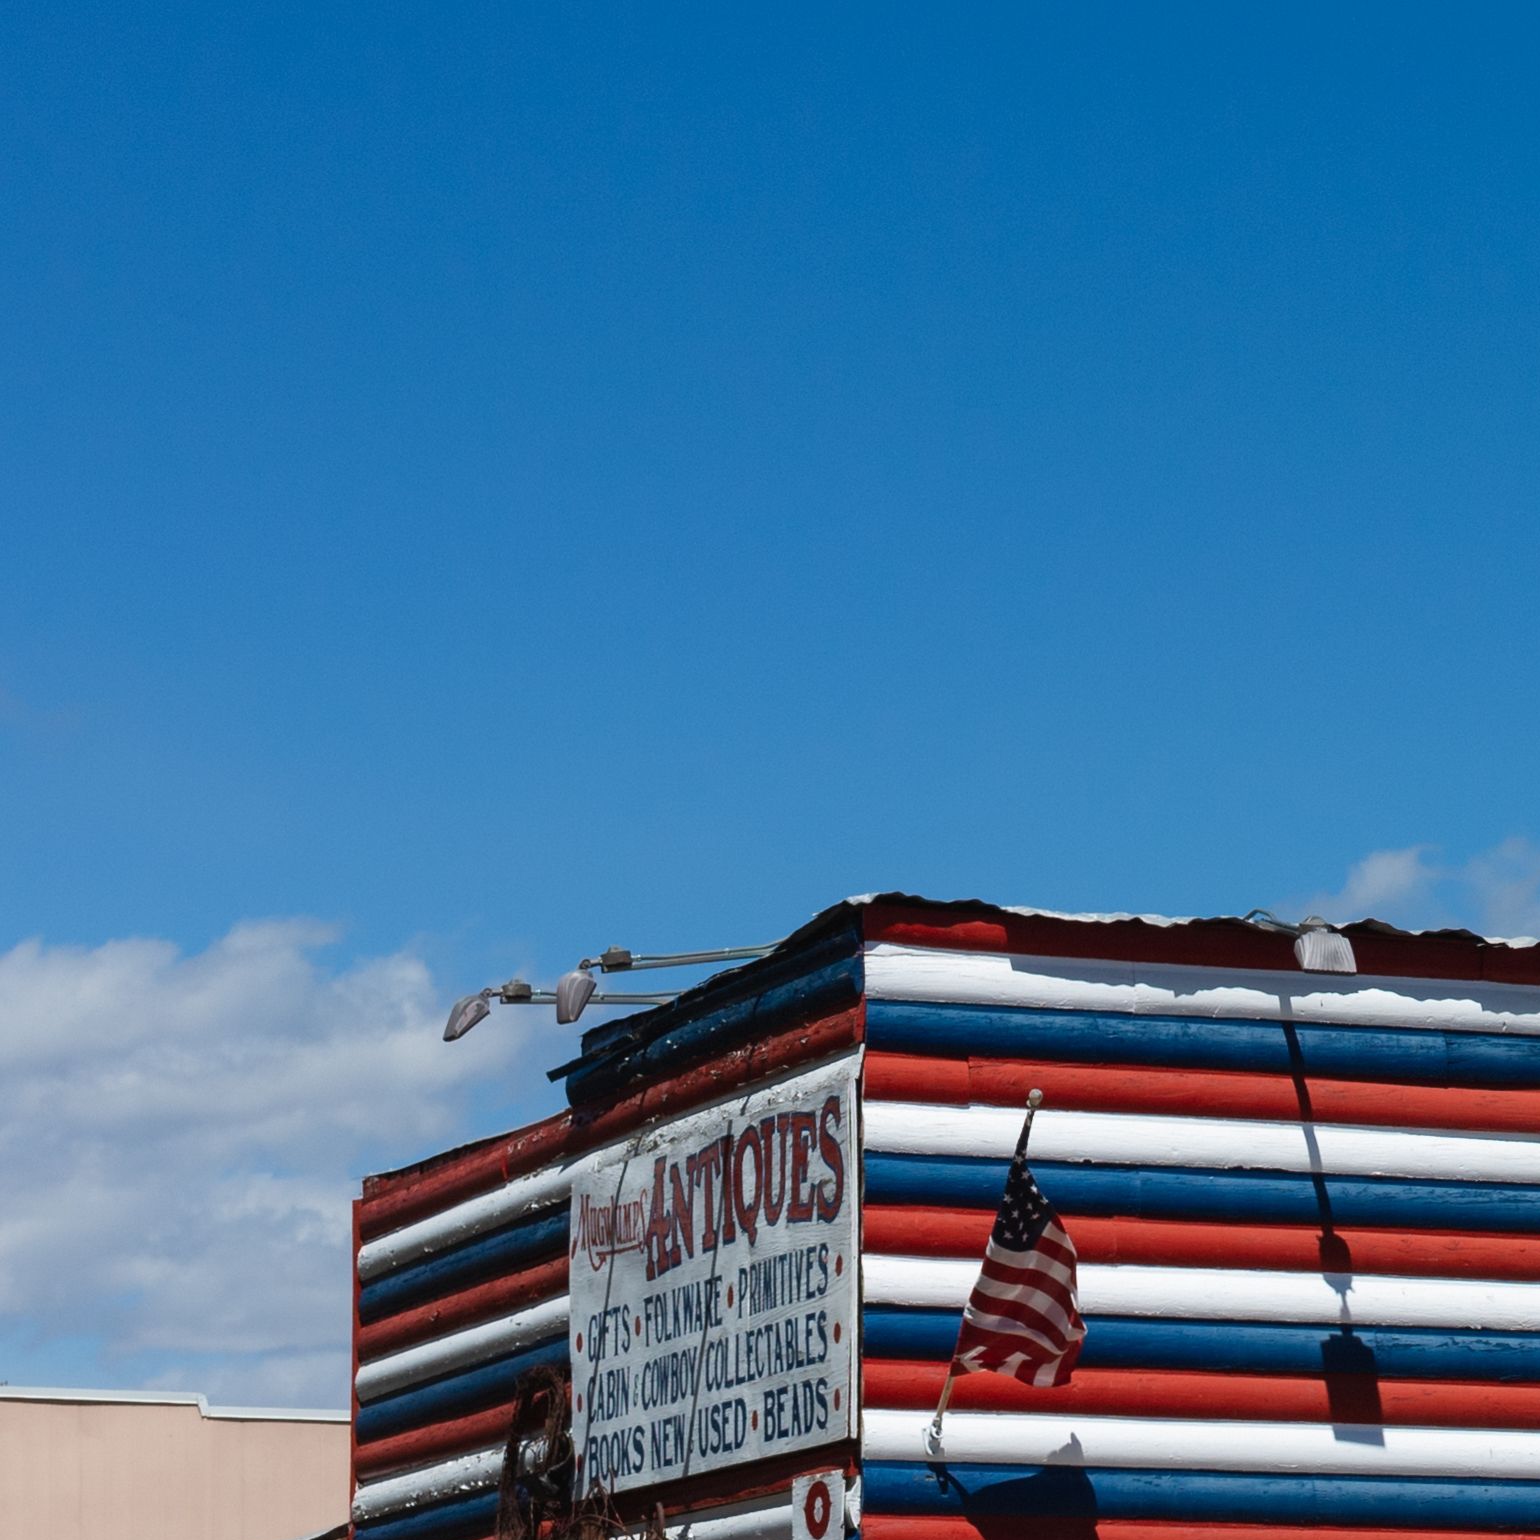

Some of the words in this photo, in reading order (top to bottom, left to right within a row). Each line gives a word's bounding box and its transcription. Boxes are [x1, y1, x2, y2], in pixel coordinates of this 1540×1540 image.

[646, 1096, 844, 1281] ANTIQUES
[588, 1304, 631, 1363] GIFTS
[643, 1275, 722, 1347] FOLKWARE
[738, 1243, 829, 1319] PRIMITIVES
[587, 1366, 630, 1424] CABIN
[641, 1346, 698, 1411] COWBOY
[705, 1310, 828, 1392] COLLECTABLES
[588, 1425, 646, 1483] BOOKS
[651, 1413, 686, 1470] NEW
[698, 1398, 748, 1459] USED
[763, 1378, 829, 1442] BEADS
